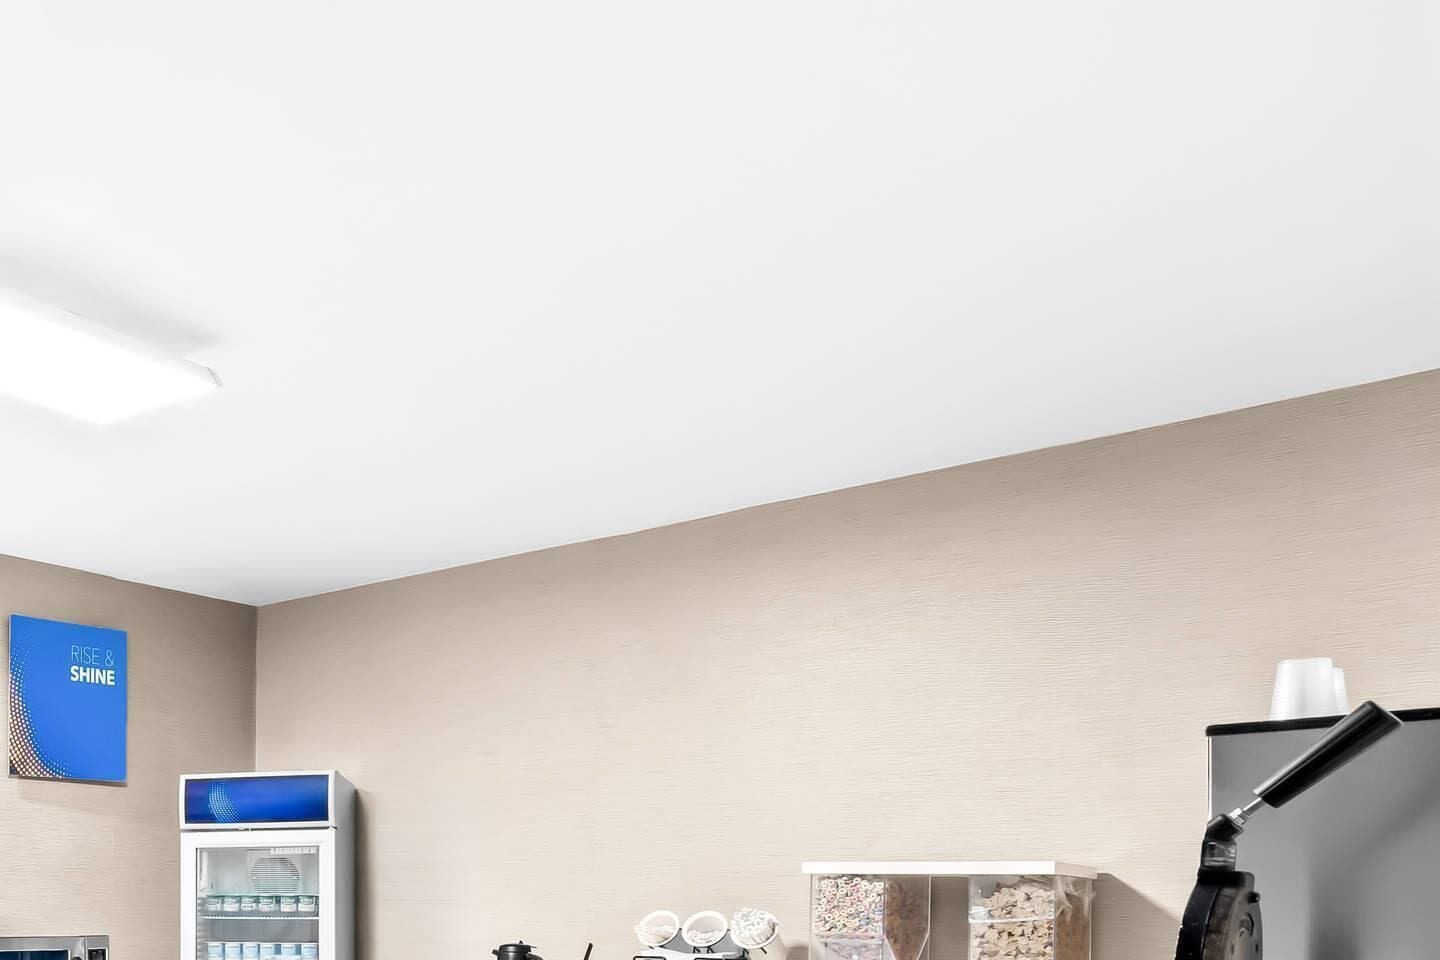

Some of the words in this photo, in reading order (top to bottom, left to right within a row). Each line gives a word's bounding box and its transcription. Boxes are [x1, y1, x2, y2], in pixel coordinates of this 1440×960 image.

[71, 645, 100, 665] RISE
[104, 649, 114, 667] &
[70, 665, 116, 686] SHINE
